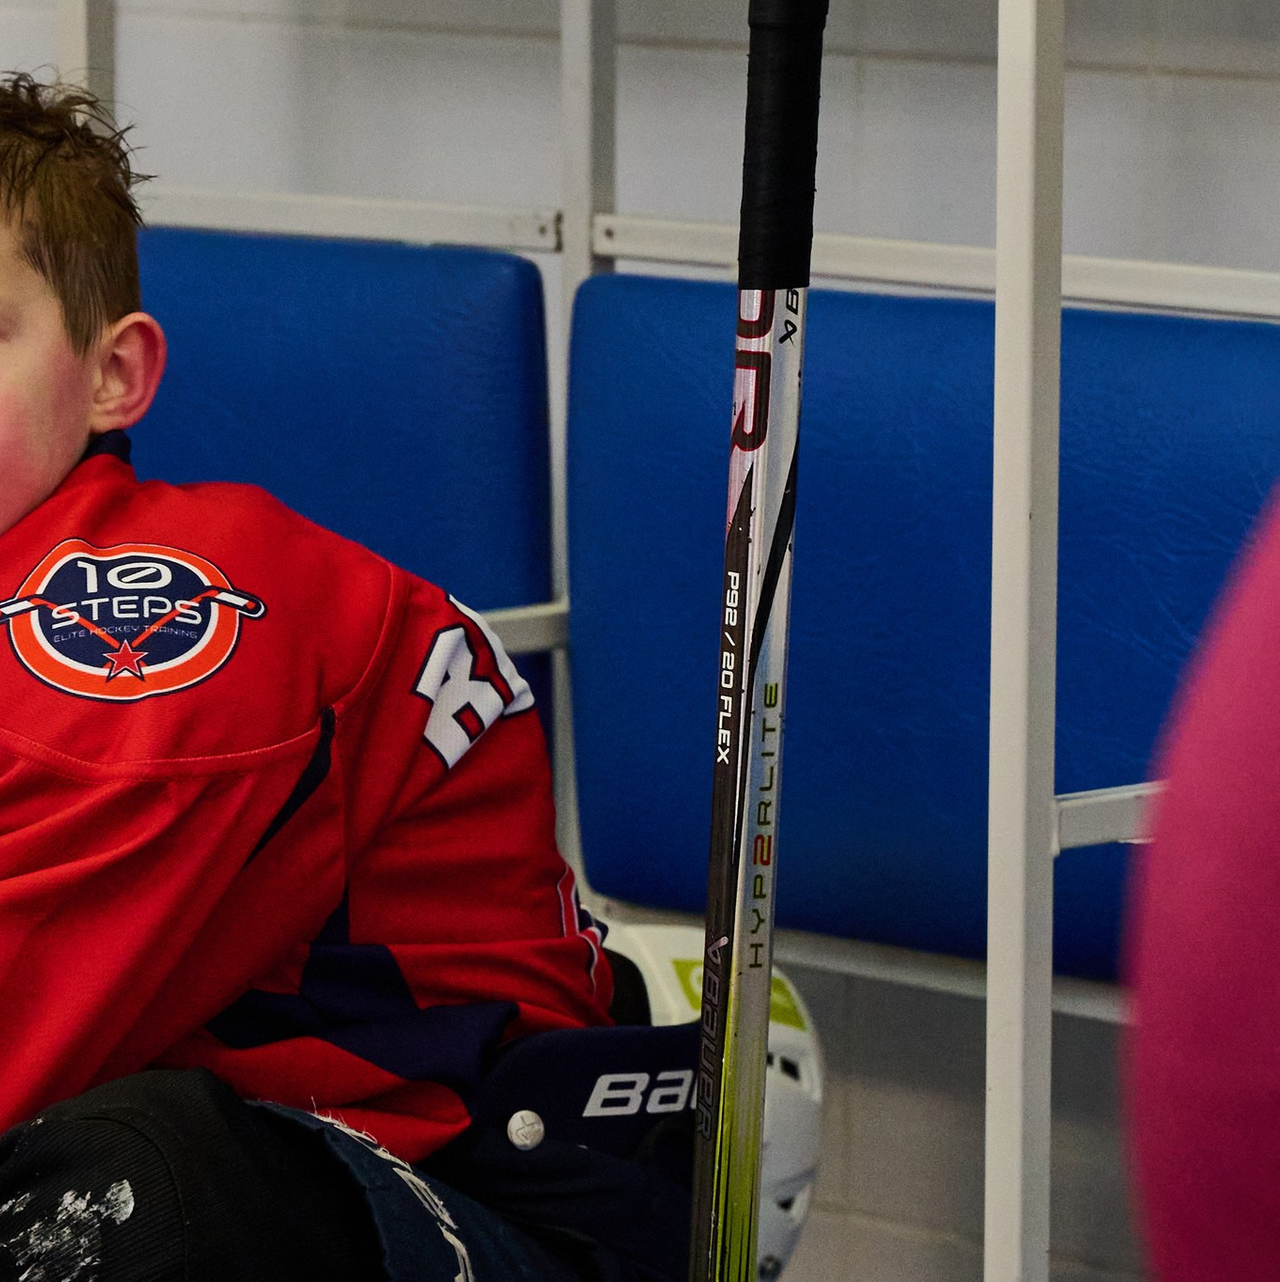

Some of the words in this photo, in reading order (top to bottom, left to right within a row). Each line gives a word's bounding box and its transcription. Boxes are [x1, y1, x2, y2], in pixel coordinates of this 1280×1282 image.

[77, 561, 173, 594] 10
[51, 595, 203, 630] STEPS
[724, 571, 740, 625] P92
[53, 628, 86, 643] ELITE
[89, 624, 140, 637] HOCKEY
[143, 625, 199, 640] TRAINING
[720, 652, 734, 688] 20
[716, 694, 732, 764] FLEX
[749, 682, 778, 969] HYP2RLITE
